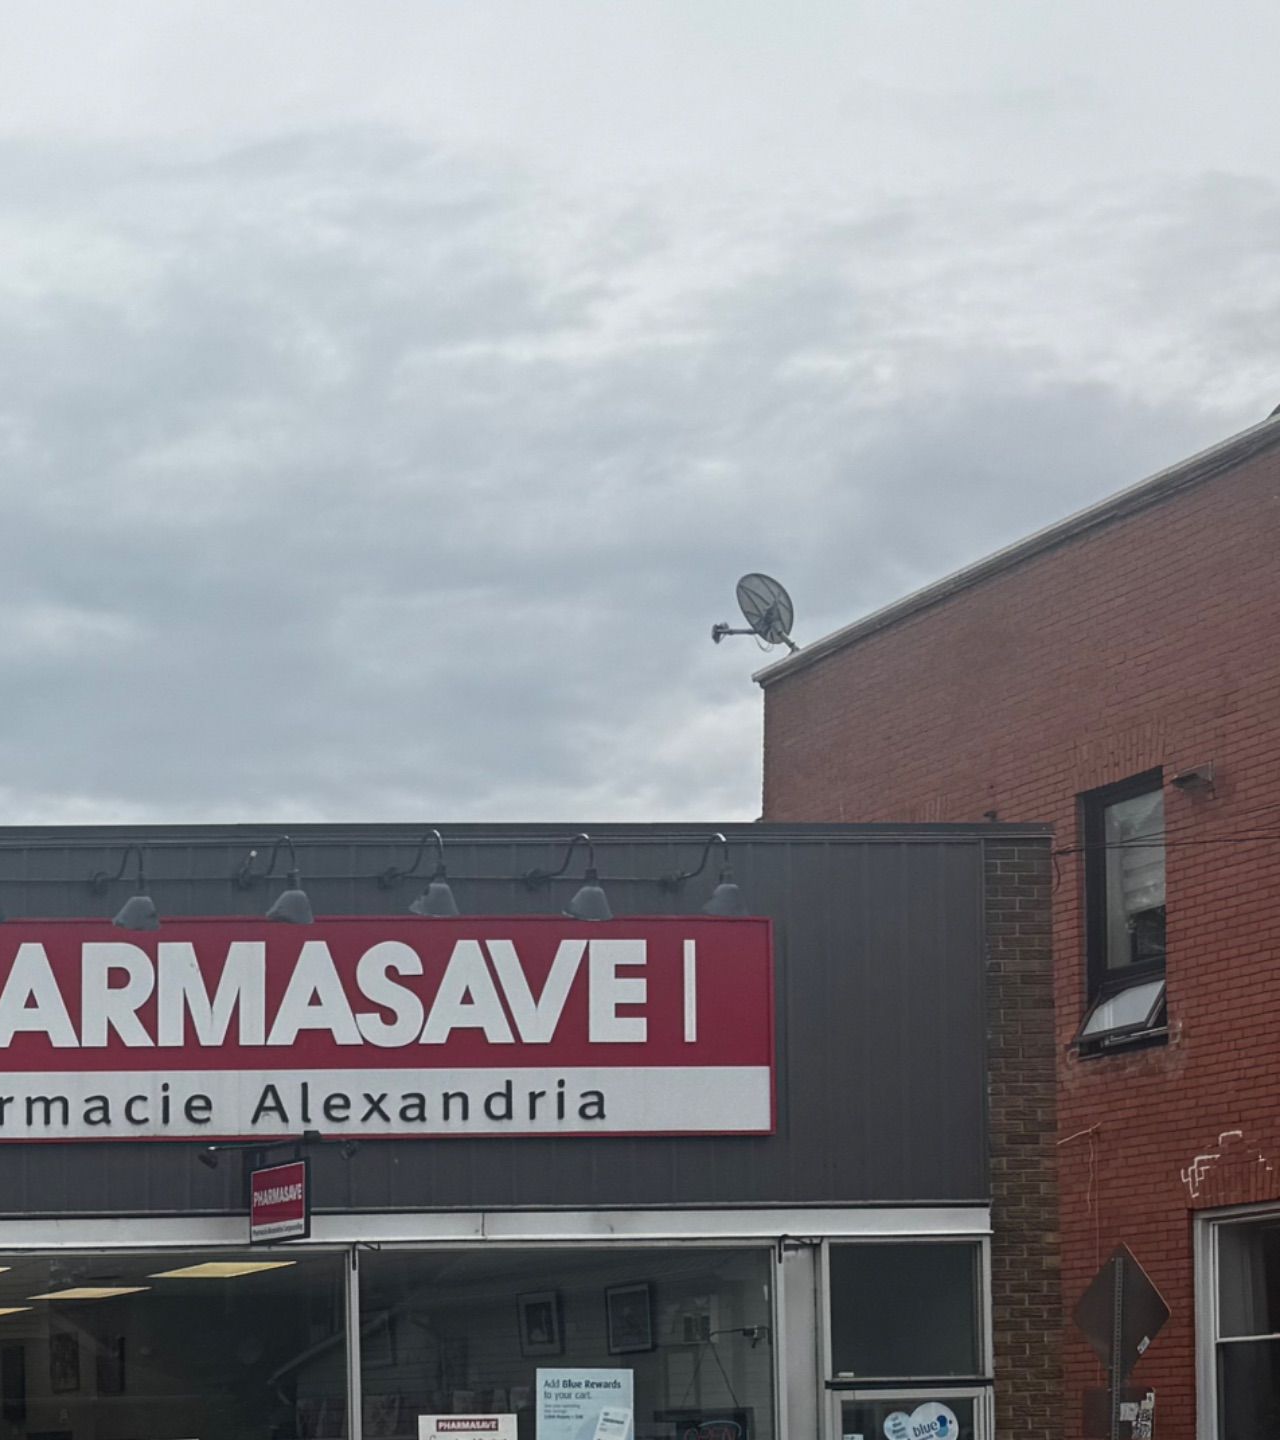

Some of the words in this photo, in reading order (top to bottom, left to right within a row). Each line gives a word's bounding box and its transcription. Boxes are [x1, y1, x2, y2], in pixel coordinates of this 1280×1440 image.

[252, 1079, 607, 1124] Alexandria
[253, 1183, 302, 1208] PHARMASAVE
[544, 1380, 561, 1388] Add
[562, 1380, 583, 1389] Blue
[585, 1379, 622, 1389] Rewards
[554, 1392, 572, 1401] your
[438, 1421, 497, 1430] PHARMASAVE
[913, 1420, 938, 1438] blue
